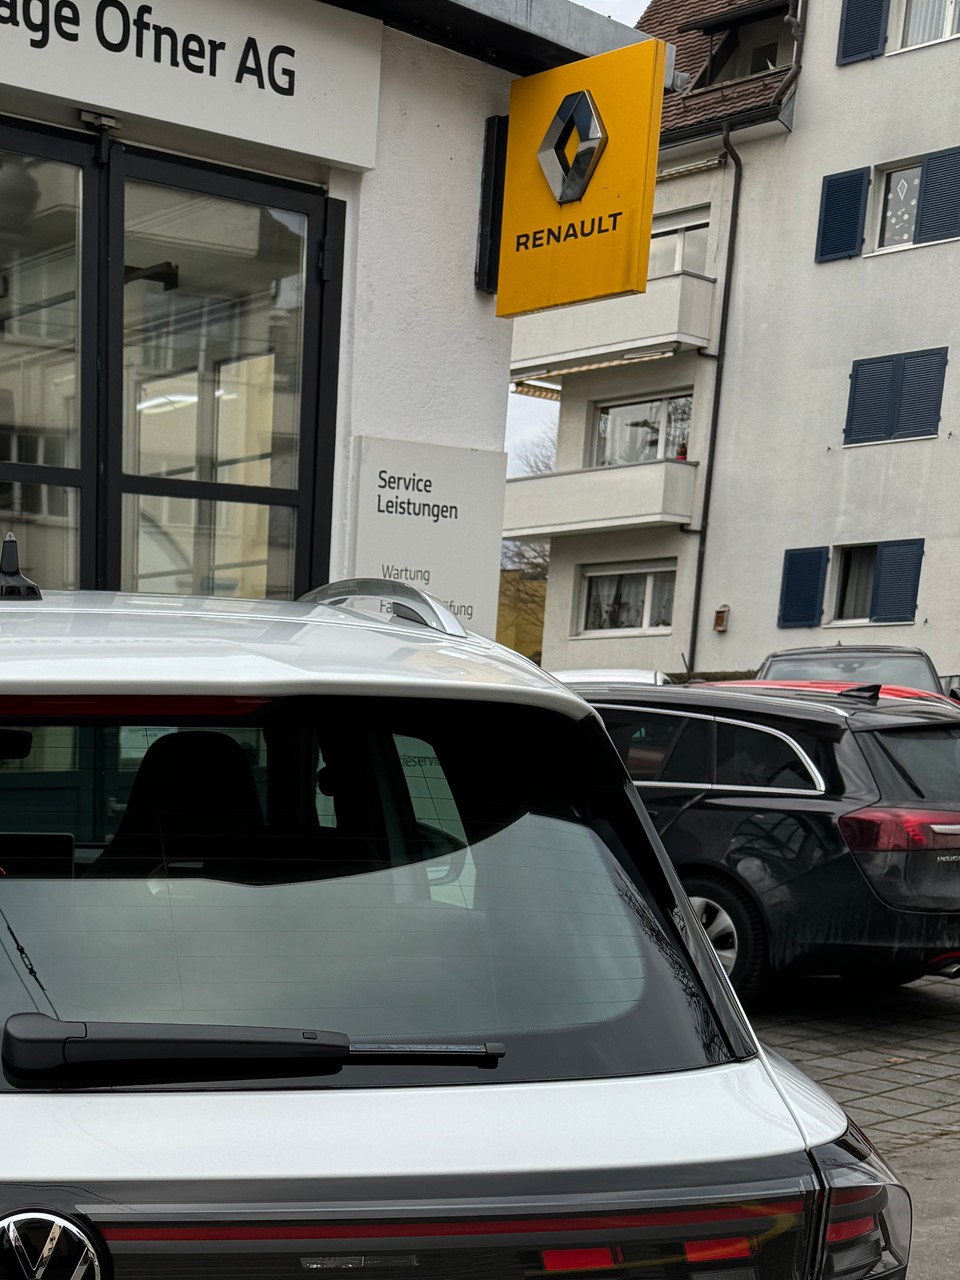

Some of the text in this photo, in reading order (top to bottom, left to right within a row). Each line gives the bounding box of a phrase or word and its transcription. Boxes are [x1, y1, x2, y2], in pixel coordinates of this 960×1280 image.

[95, 0, 226, 77] Ofner
[235, 36, 296, 96] AG
[515, 211, 623, 252] RENAULT
[377, 469, 433, 493] Service
[377, 494, 458, 523] Leistungen
[381, 564, 431, 585] Wartung
